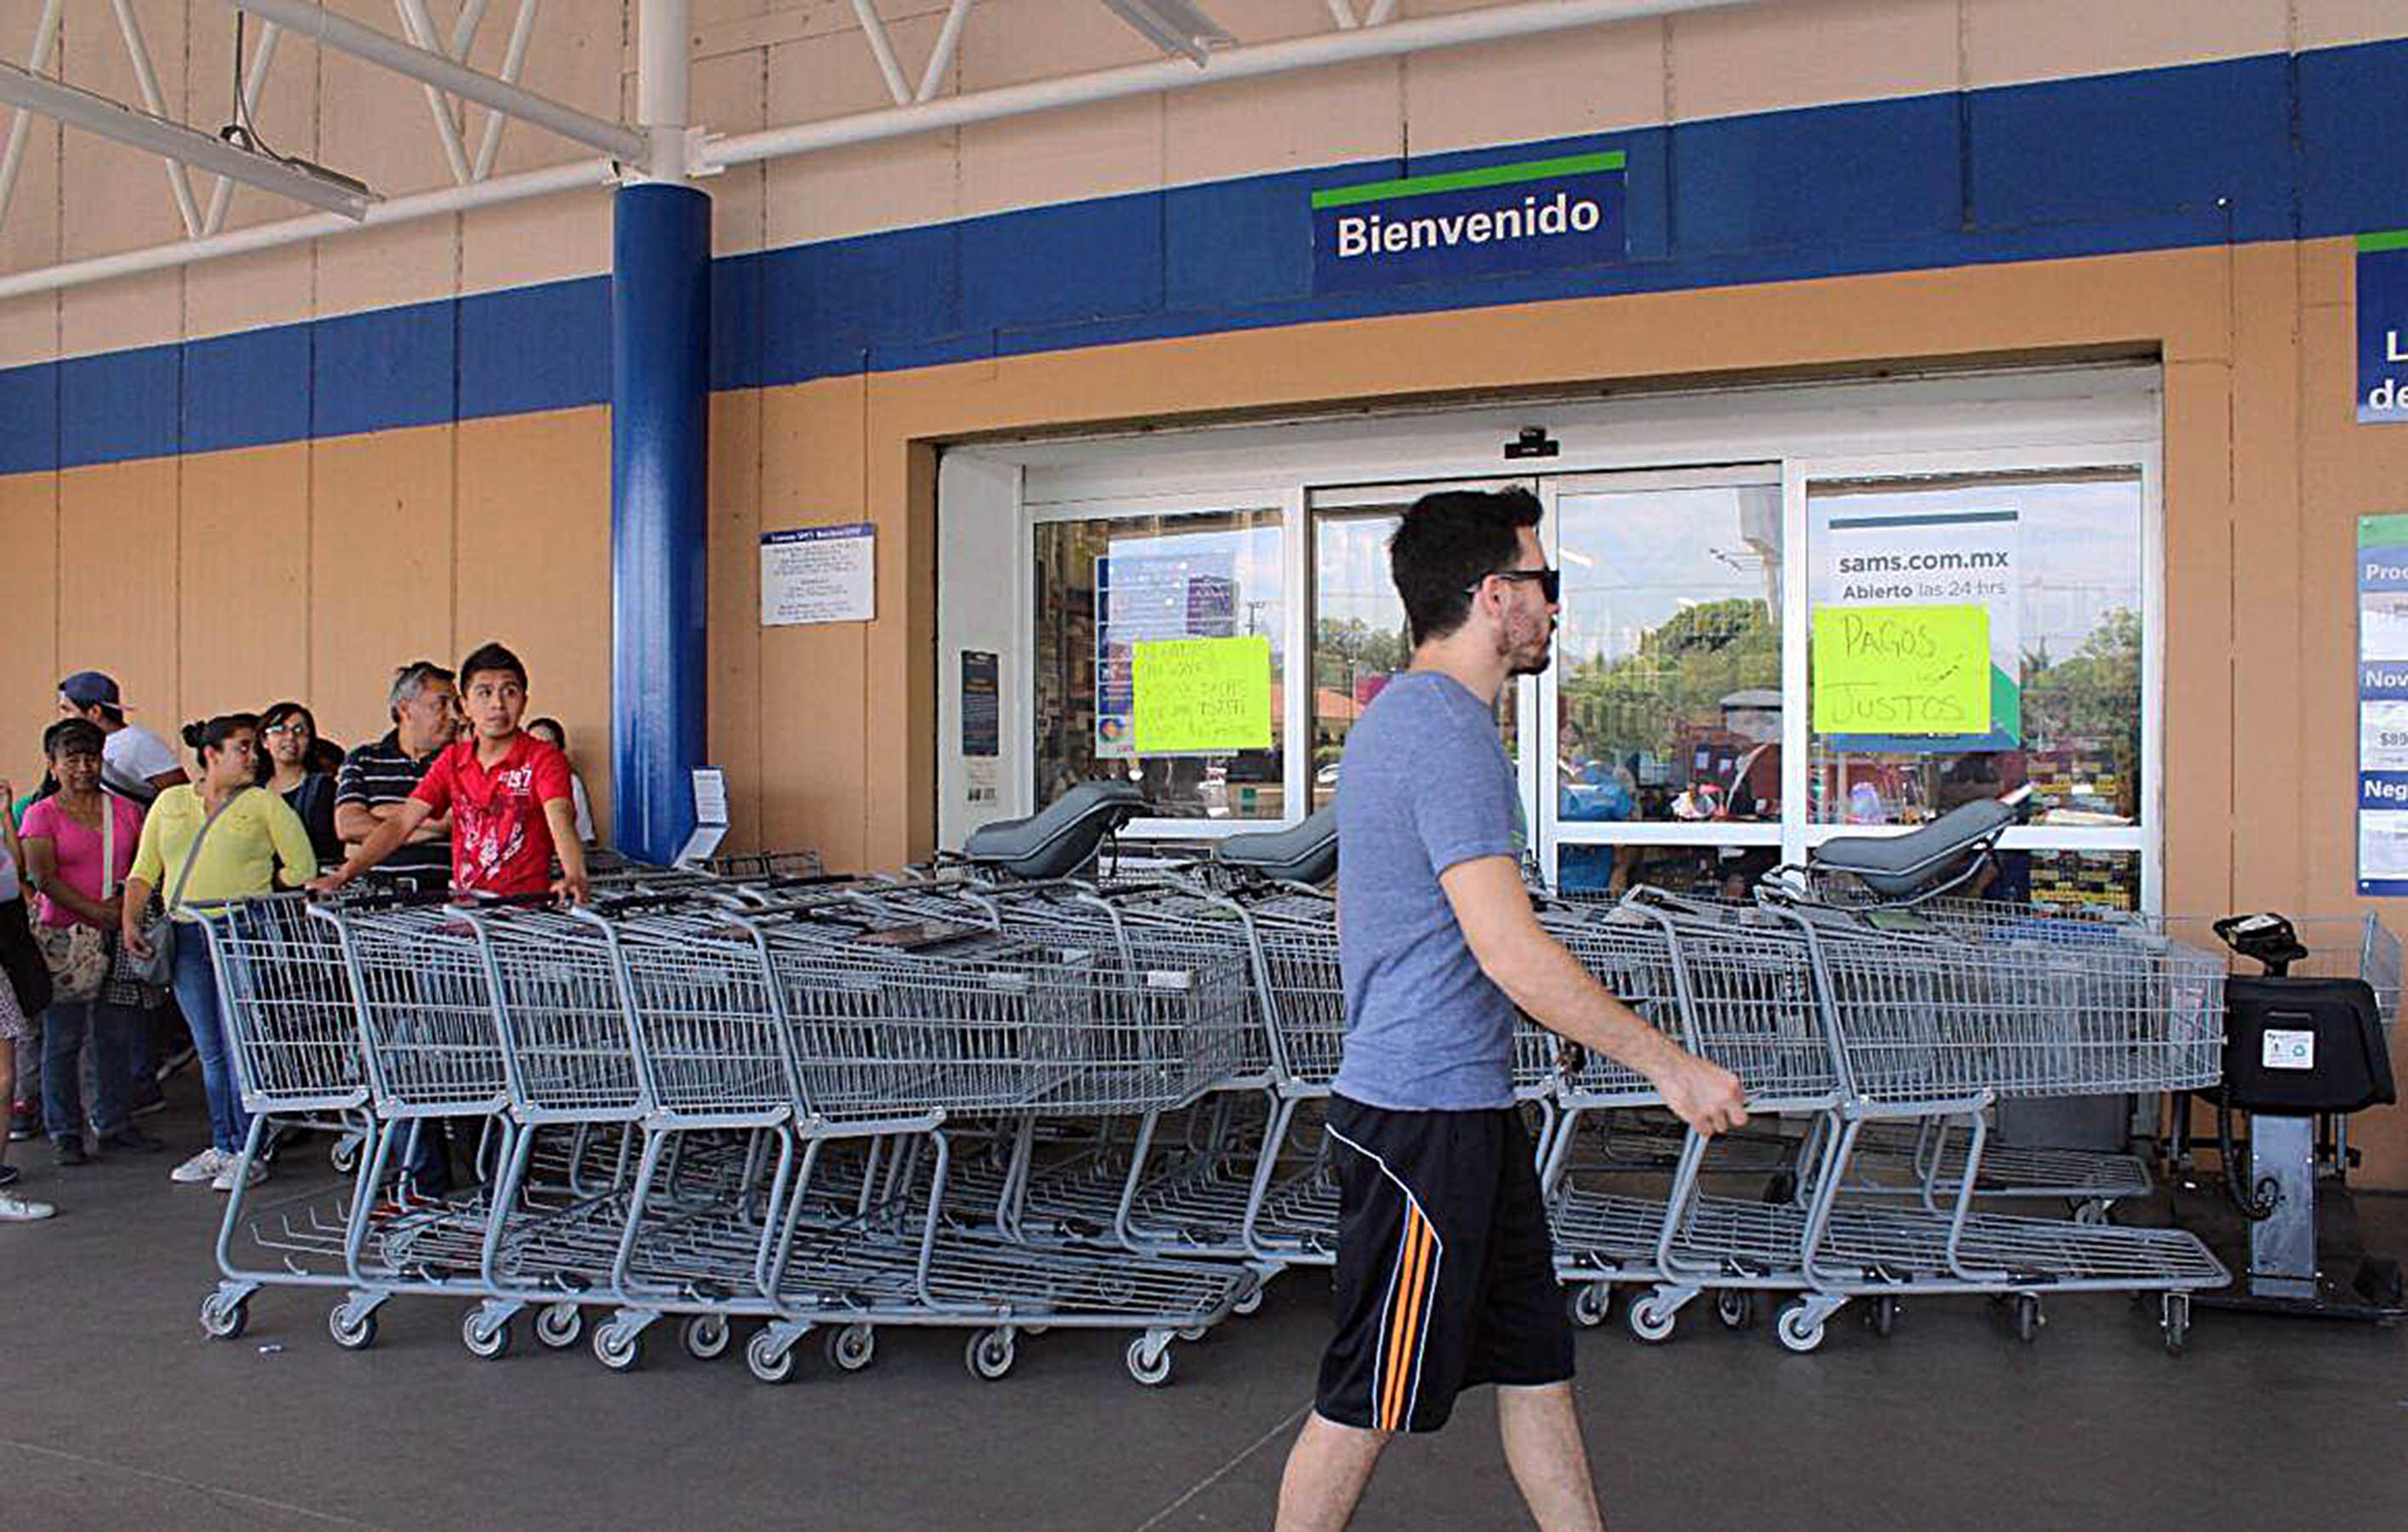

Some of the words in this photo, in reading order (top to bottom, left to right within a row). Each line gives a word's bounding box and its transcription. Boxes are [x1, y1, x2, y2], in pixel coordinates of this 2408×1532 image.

[1337, 192, 1600, 258] Bienvenido
[1839, 551, 2010, 574] sams.com.mx
[1842, 584, 1913, 600] Abierto
[1918, 582, 1944, 597] las
[1948, 580, 1972, 597] 24
[1976, 578, 2007, 596] hrs
[1841, 613, 1937, 659] PAGOS
[1825, 681, 1965, 725] JUSTOS
